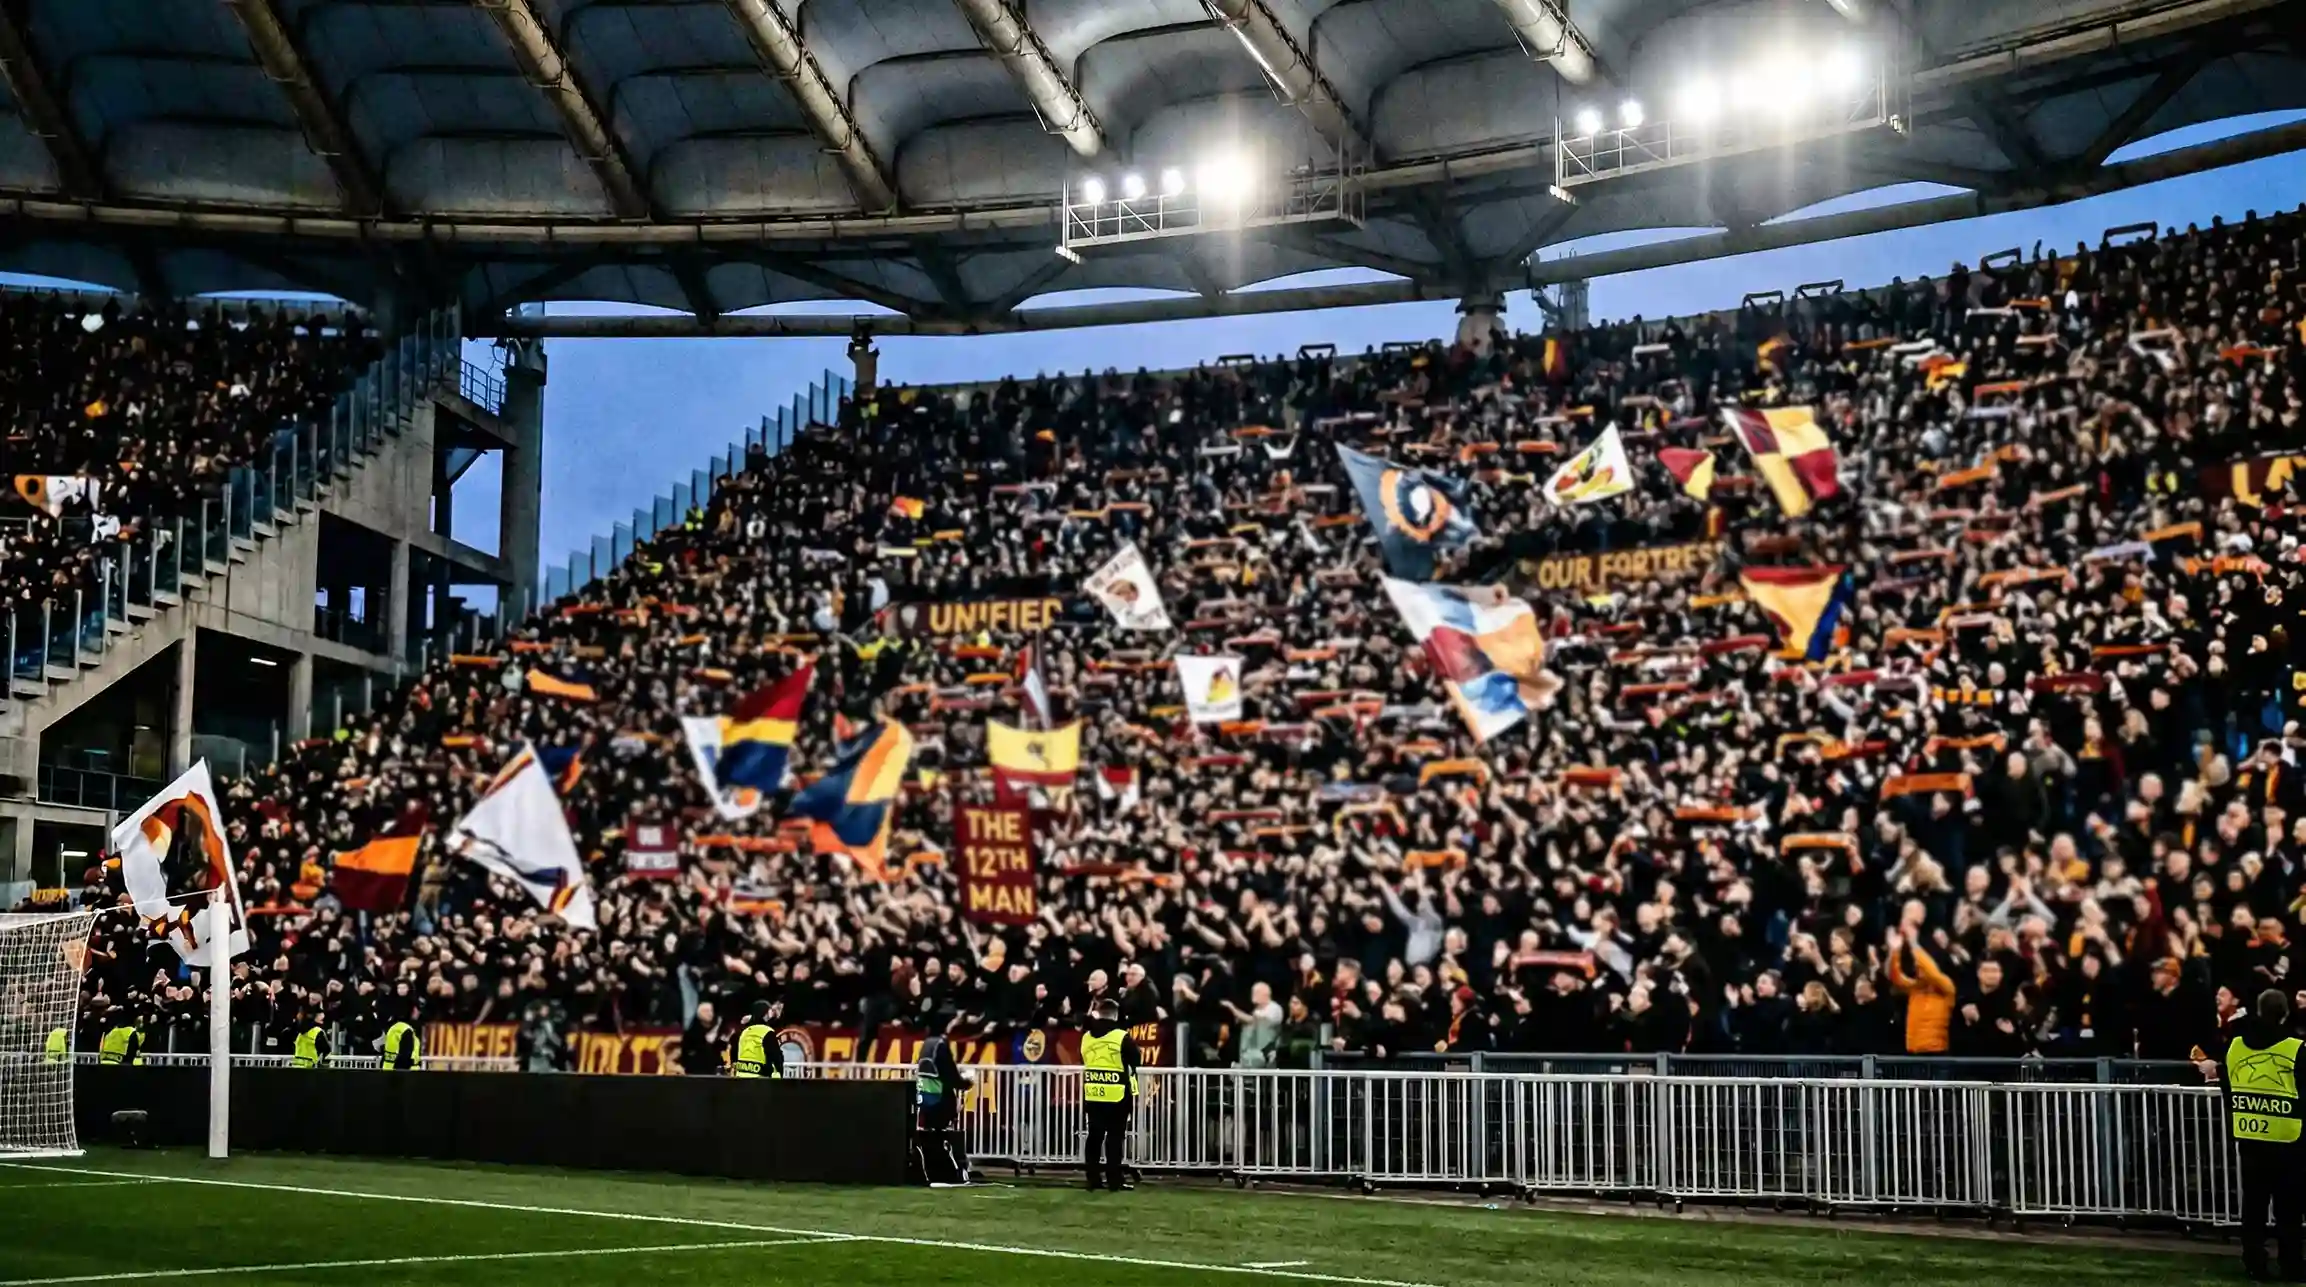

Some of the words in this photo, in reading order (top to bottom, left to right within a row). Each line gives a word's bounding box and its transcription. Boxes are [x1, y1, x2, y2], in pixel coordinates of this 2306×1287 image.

[1538, 556, 1593, 589] OUR
[965, 808, 1022, 841] THE
[964, 847, 1028, 877] 12TH
[968, 882, 1033, 914] MAN
[2231, 1095, 2292, 1114] SEWARD
[2238, 1117, 2270, 1134] 002
